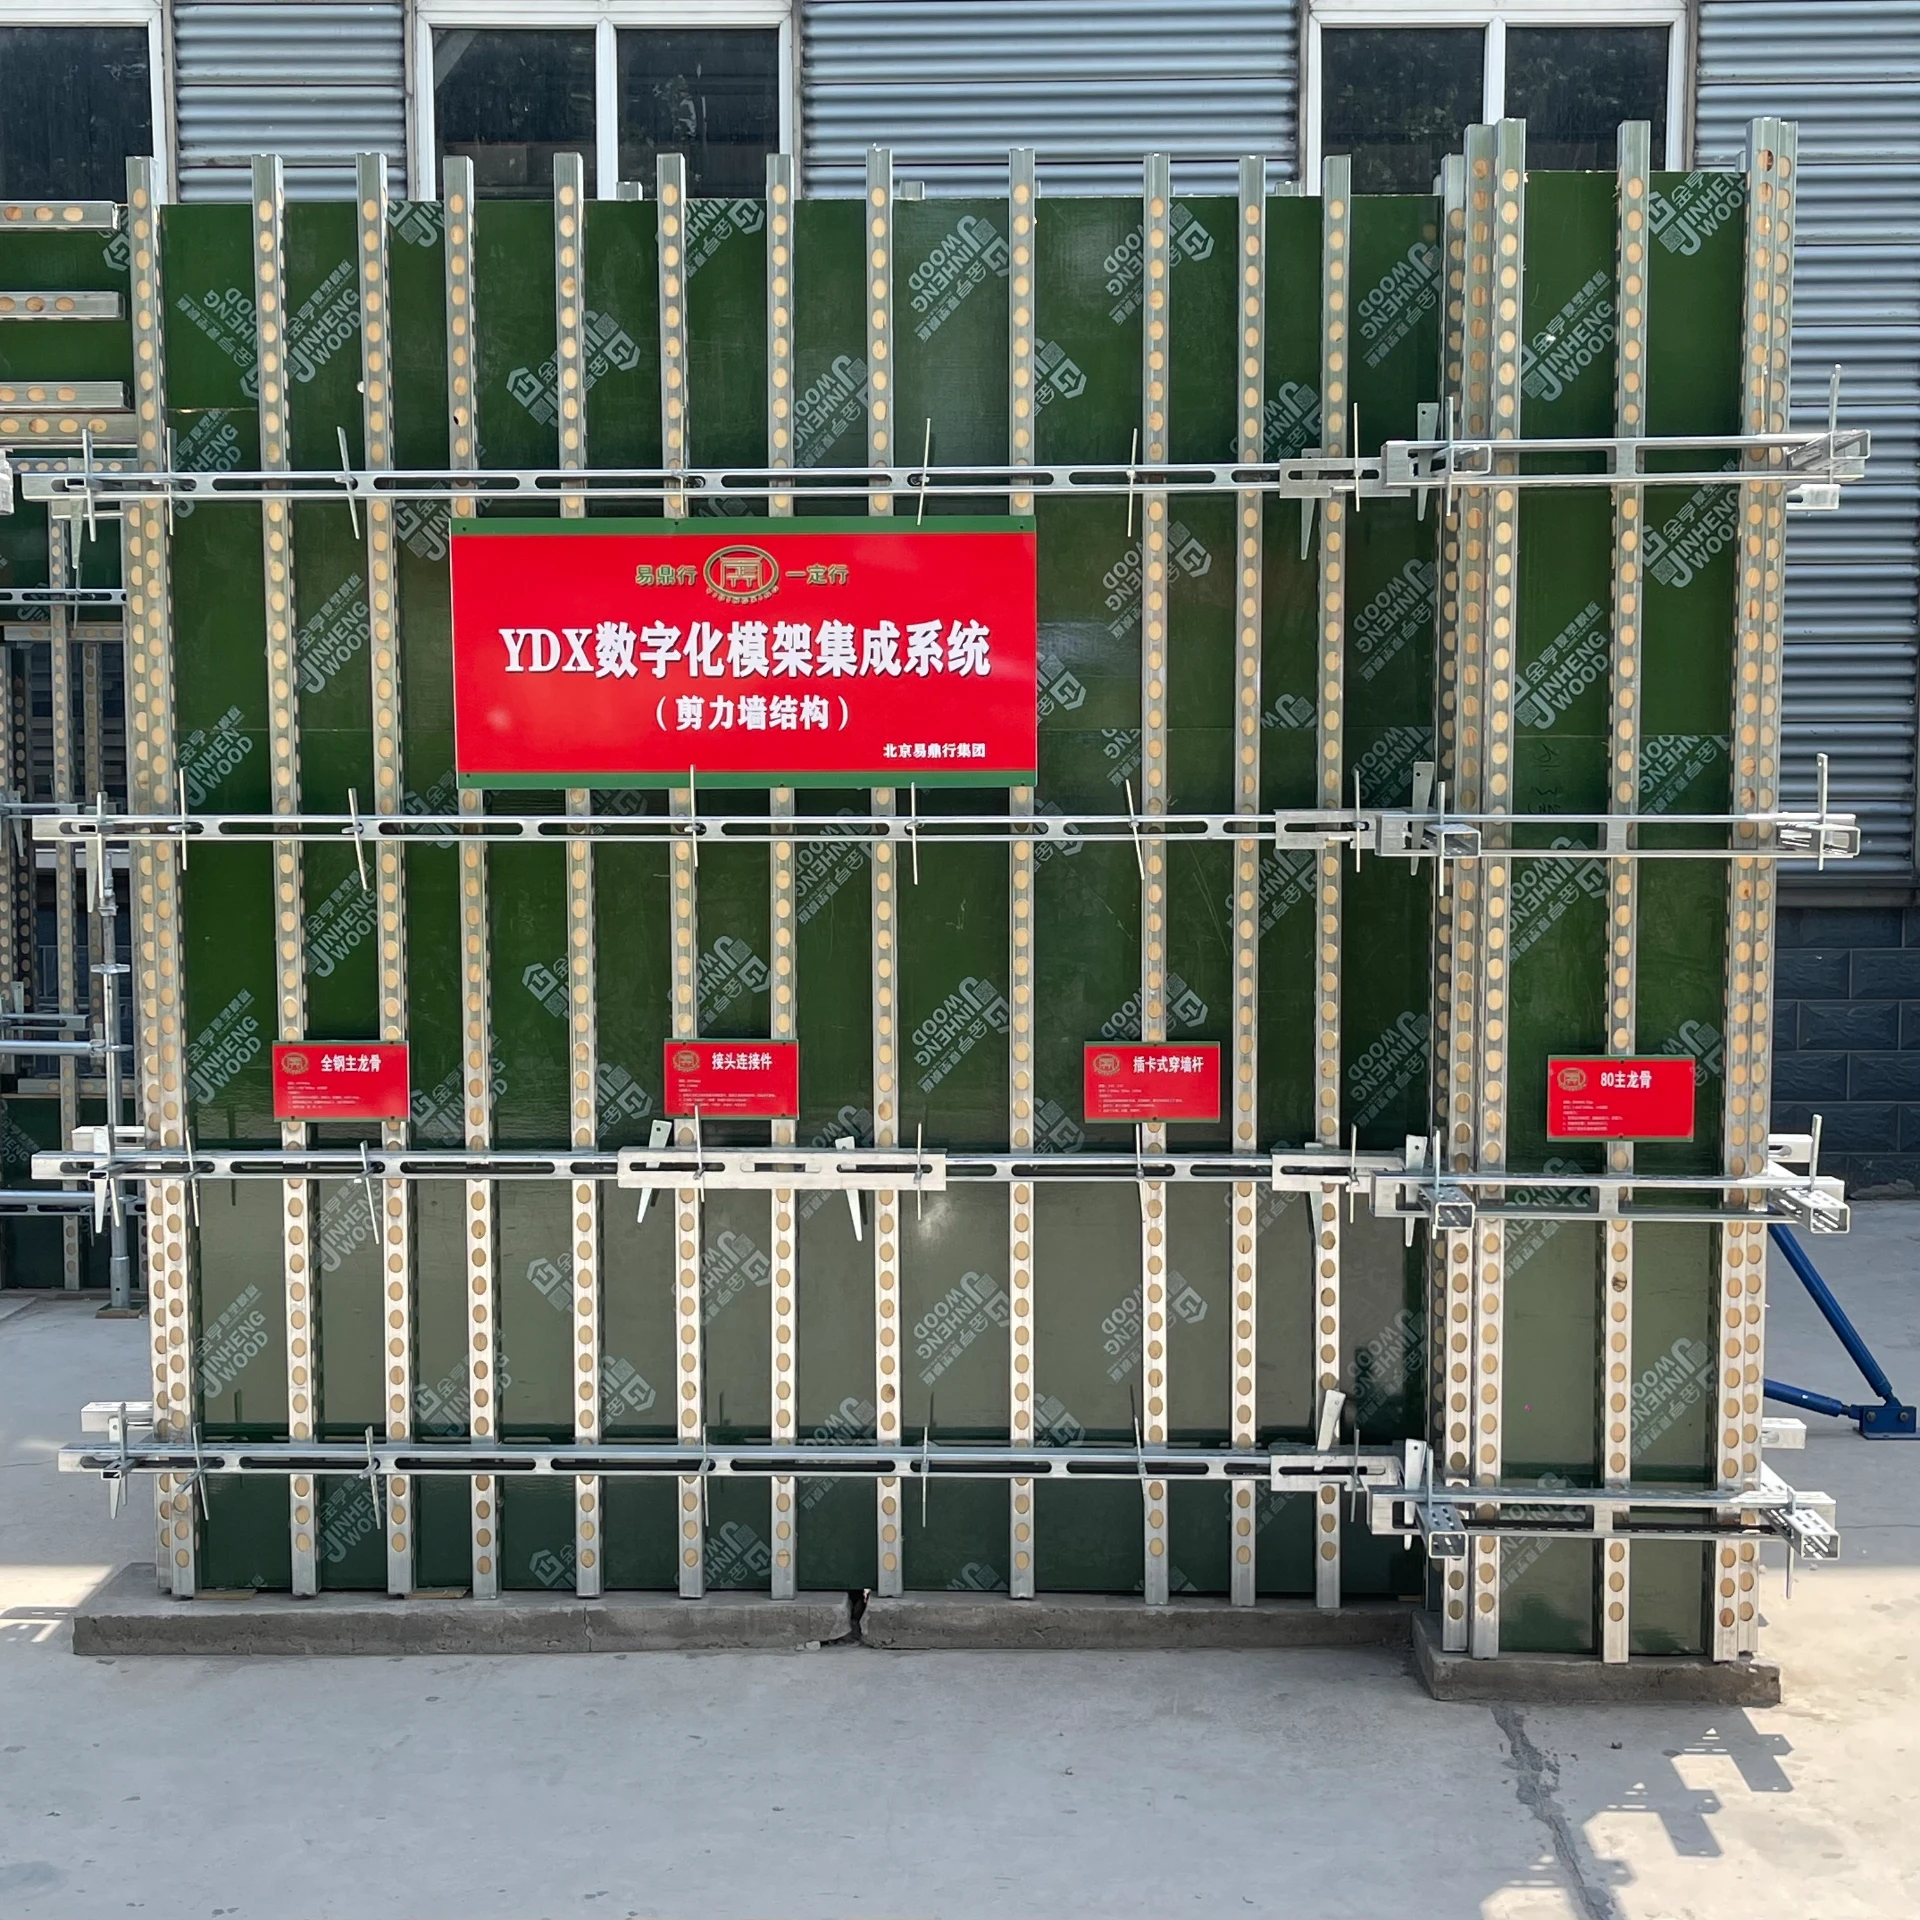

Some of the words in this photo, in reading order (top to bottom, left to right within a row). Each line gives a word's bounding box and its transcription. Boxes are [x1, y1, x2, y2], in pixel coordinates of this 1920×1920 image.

[908, 234, 962, 290] WOOD
[910, 215, 981, 312] JINHENG
[1358, 261, 1412, 317] WOOD
[1359, 242, 1432, 339] JINHENG
[290, 288, 360, 382] JINHENG
[311, 311, 361, 366] WOOD
[1537, 300, 1614, 401] JINHENG
[1559, 324, 1614, 382] WOOD
[635, 565, 698, 586] 易鼎行
[786, 564, 849, 586] 一定行
[1353, 577, 1407, 631] WOOD
[1355, 559, 1427, 653] JINHENG
[300, 601, 369, 693] JINHENG
[320, 623, 370, 676] WOOD
[499, 619, 991, 679] YDX数字化模架集成系统
[1530, 631, 1607, 729] JINHENG
[1551, 653, 1608, 711] WOOD
[656, 695, 850, 731] （剪力墙结构）
[202, 736, 253, 790] WOOD
[883, 742, 987, 760] 北京易鼎行集团
[311, 888, 377, 977] JINHENG
[330, 909, 378, 960] WOOD
[912, 994, 964, 1046] WOOD
[914, 977, 983, 1067] JINHENG
[191, 1016, 259, 1104] JINHENG
[210, 1037, 261, 1087] WOOD
[320, 1054, 382, 1073] 全钢主龙骨
[711, 1052, 773, 1071] 接头连接件
[1133, 1055, 1205, 1074] 插卡式穿墙杆
[1348, 1029, 1401, 1080] WOOD
[1350, 1011, 1421, 1101] JINHENG
[1600, 1070, 1653, 1089] 80主龙骨
[913, 1288, 965, 1339] WOOD
[916, 1271, 984, 1359] JINHENG
[199, 1310, 266, 1398] JINHENG
[218, 1331, 268, 1382] WOOD
[1347, 1326, 1398, 1377] WOOD
